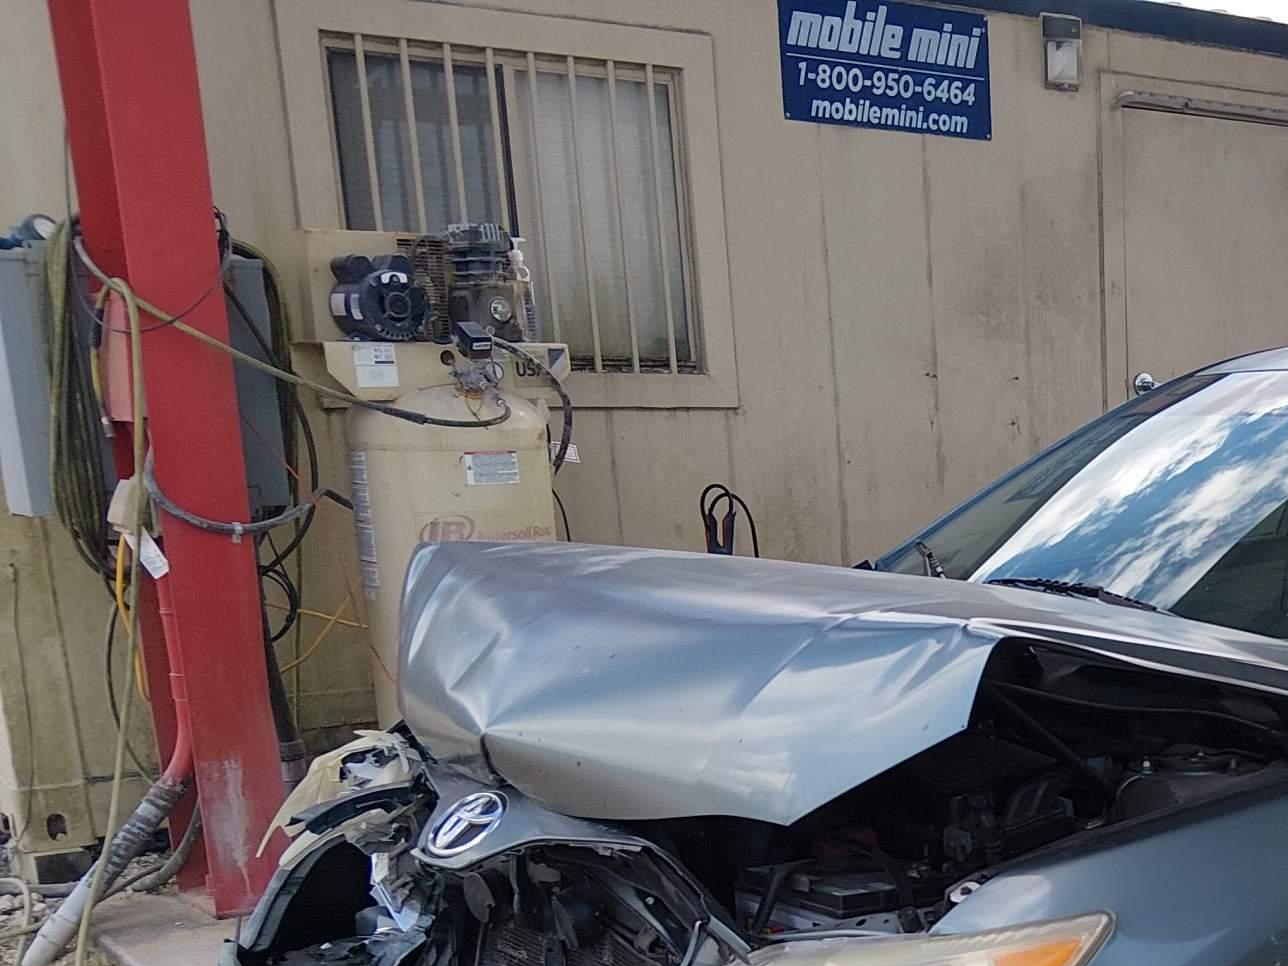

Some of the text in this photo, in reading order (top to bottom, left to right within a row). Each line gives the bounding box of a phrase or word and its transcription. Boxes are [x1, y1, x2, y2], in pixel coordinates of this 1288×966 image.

[786, 0, 982, 69] mobile mini
[798, 61, 976, 106] 1-800-950-6464
[810, 97, 968, 134] mobilemini.com
[515, 360, 540, 377] US
